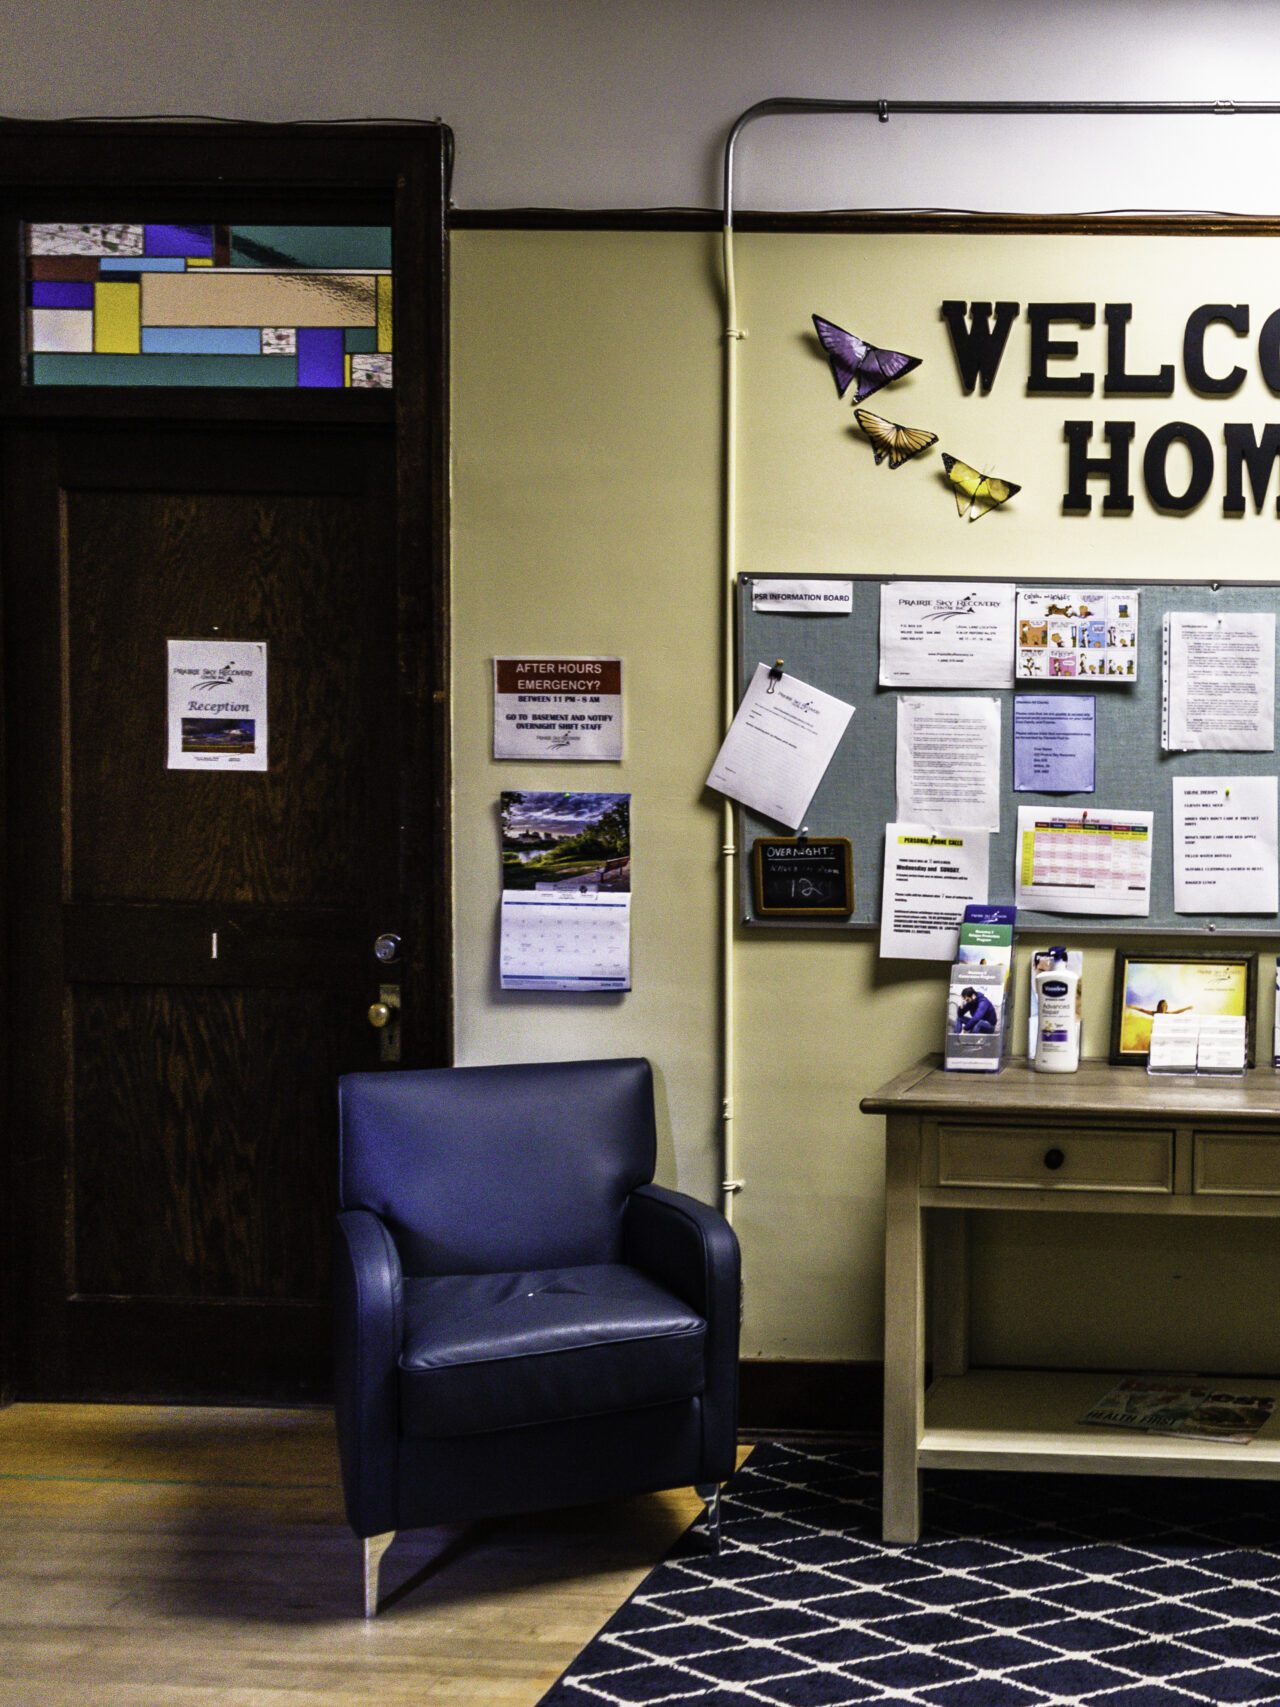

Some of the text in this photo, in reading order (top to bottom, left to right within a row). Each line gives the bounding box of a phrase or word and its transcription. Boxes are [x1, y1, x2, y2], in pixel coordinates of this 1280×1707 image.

[754, 593, 850, 602] PSR INFORMATION BOARD
[898, 598, 932, 607] PRAIRIE
[956, 600, 1000, 608] RECOVERY
[516, 663, 602, 673] AFTER HOURS
[518, 680, 601, 690] EMERGENCY?
[188, 701, 250, 715] Reception
[792, 878, 823, 897] 12
